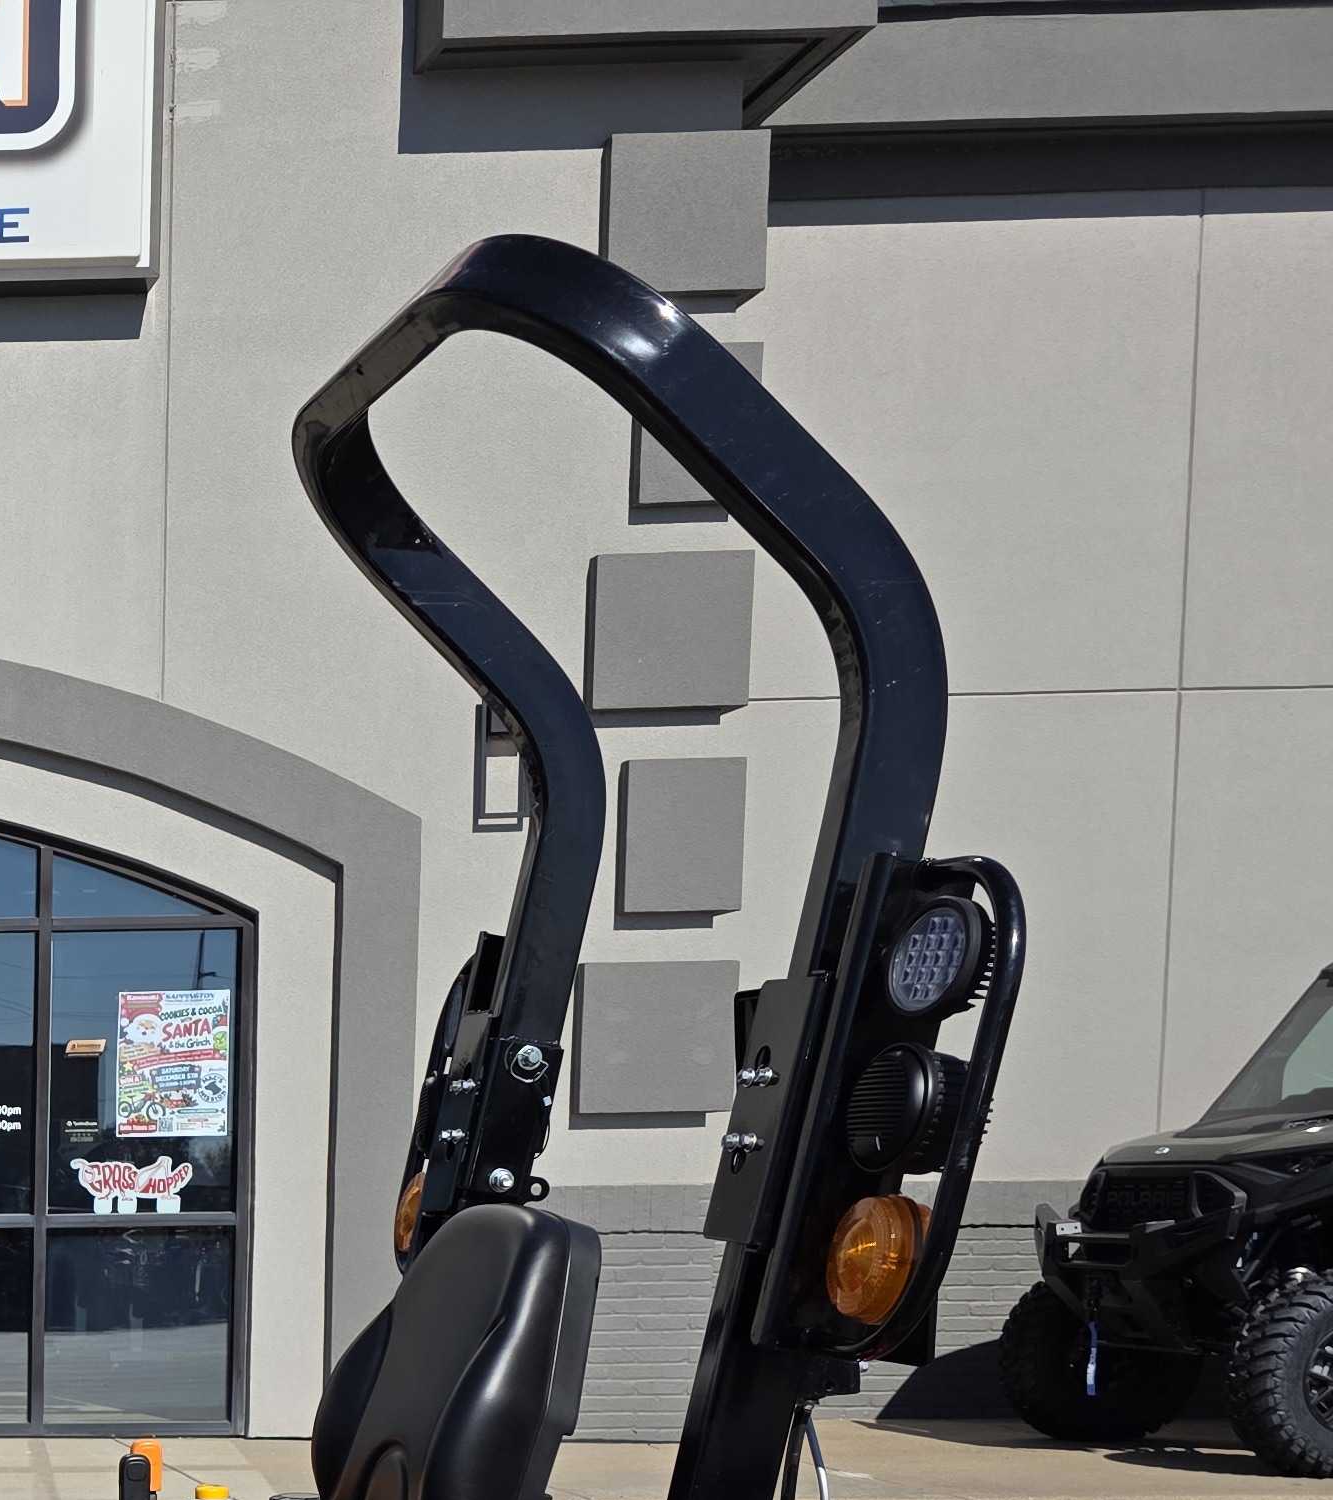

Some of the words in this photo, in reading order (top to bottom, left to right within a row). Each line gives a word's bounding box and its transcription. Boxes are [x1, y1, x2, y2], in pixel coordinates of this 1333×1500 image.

[159, 1008, 190, 1021] COOKIES
[198, 1005, 223, 1015] COCOA
[162, 1018, 212, 1042] SANTA
[186, 1037, 211, 1049] Grinch
